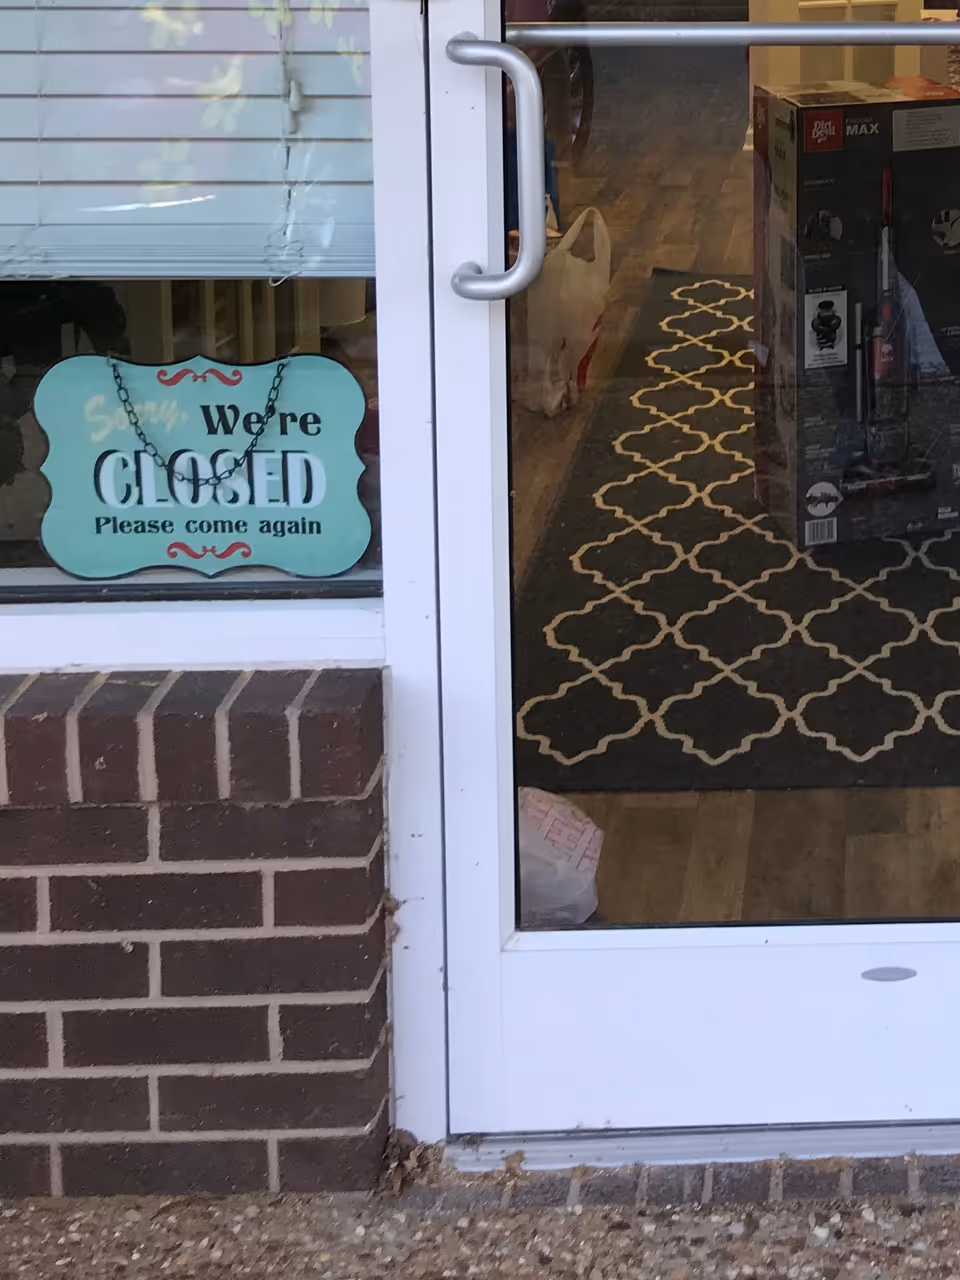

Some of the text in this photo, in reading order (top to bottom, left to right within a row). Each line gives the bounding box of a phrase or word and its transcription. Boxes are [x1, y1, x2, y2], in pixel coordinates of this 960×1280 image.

[846, 123, 880, 137] MAX
[200, 404, 322, 436] We're
[93, 449, 327, 509] CLOSED
[95, 517, 322, 537] Please come again
